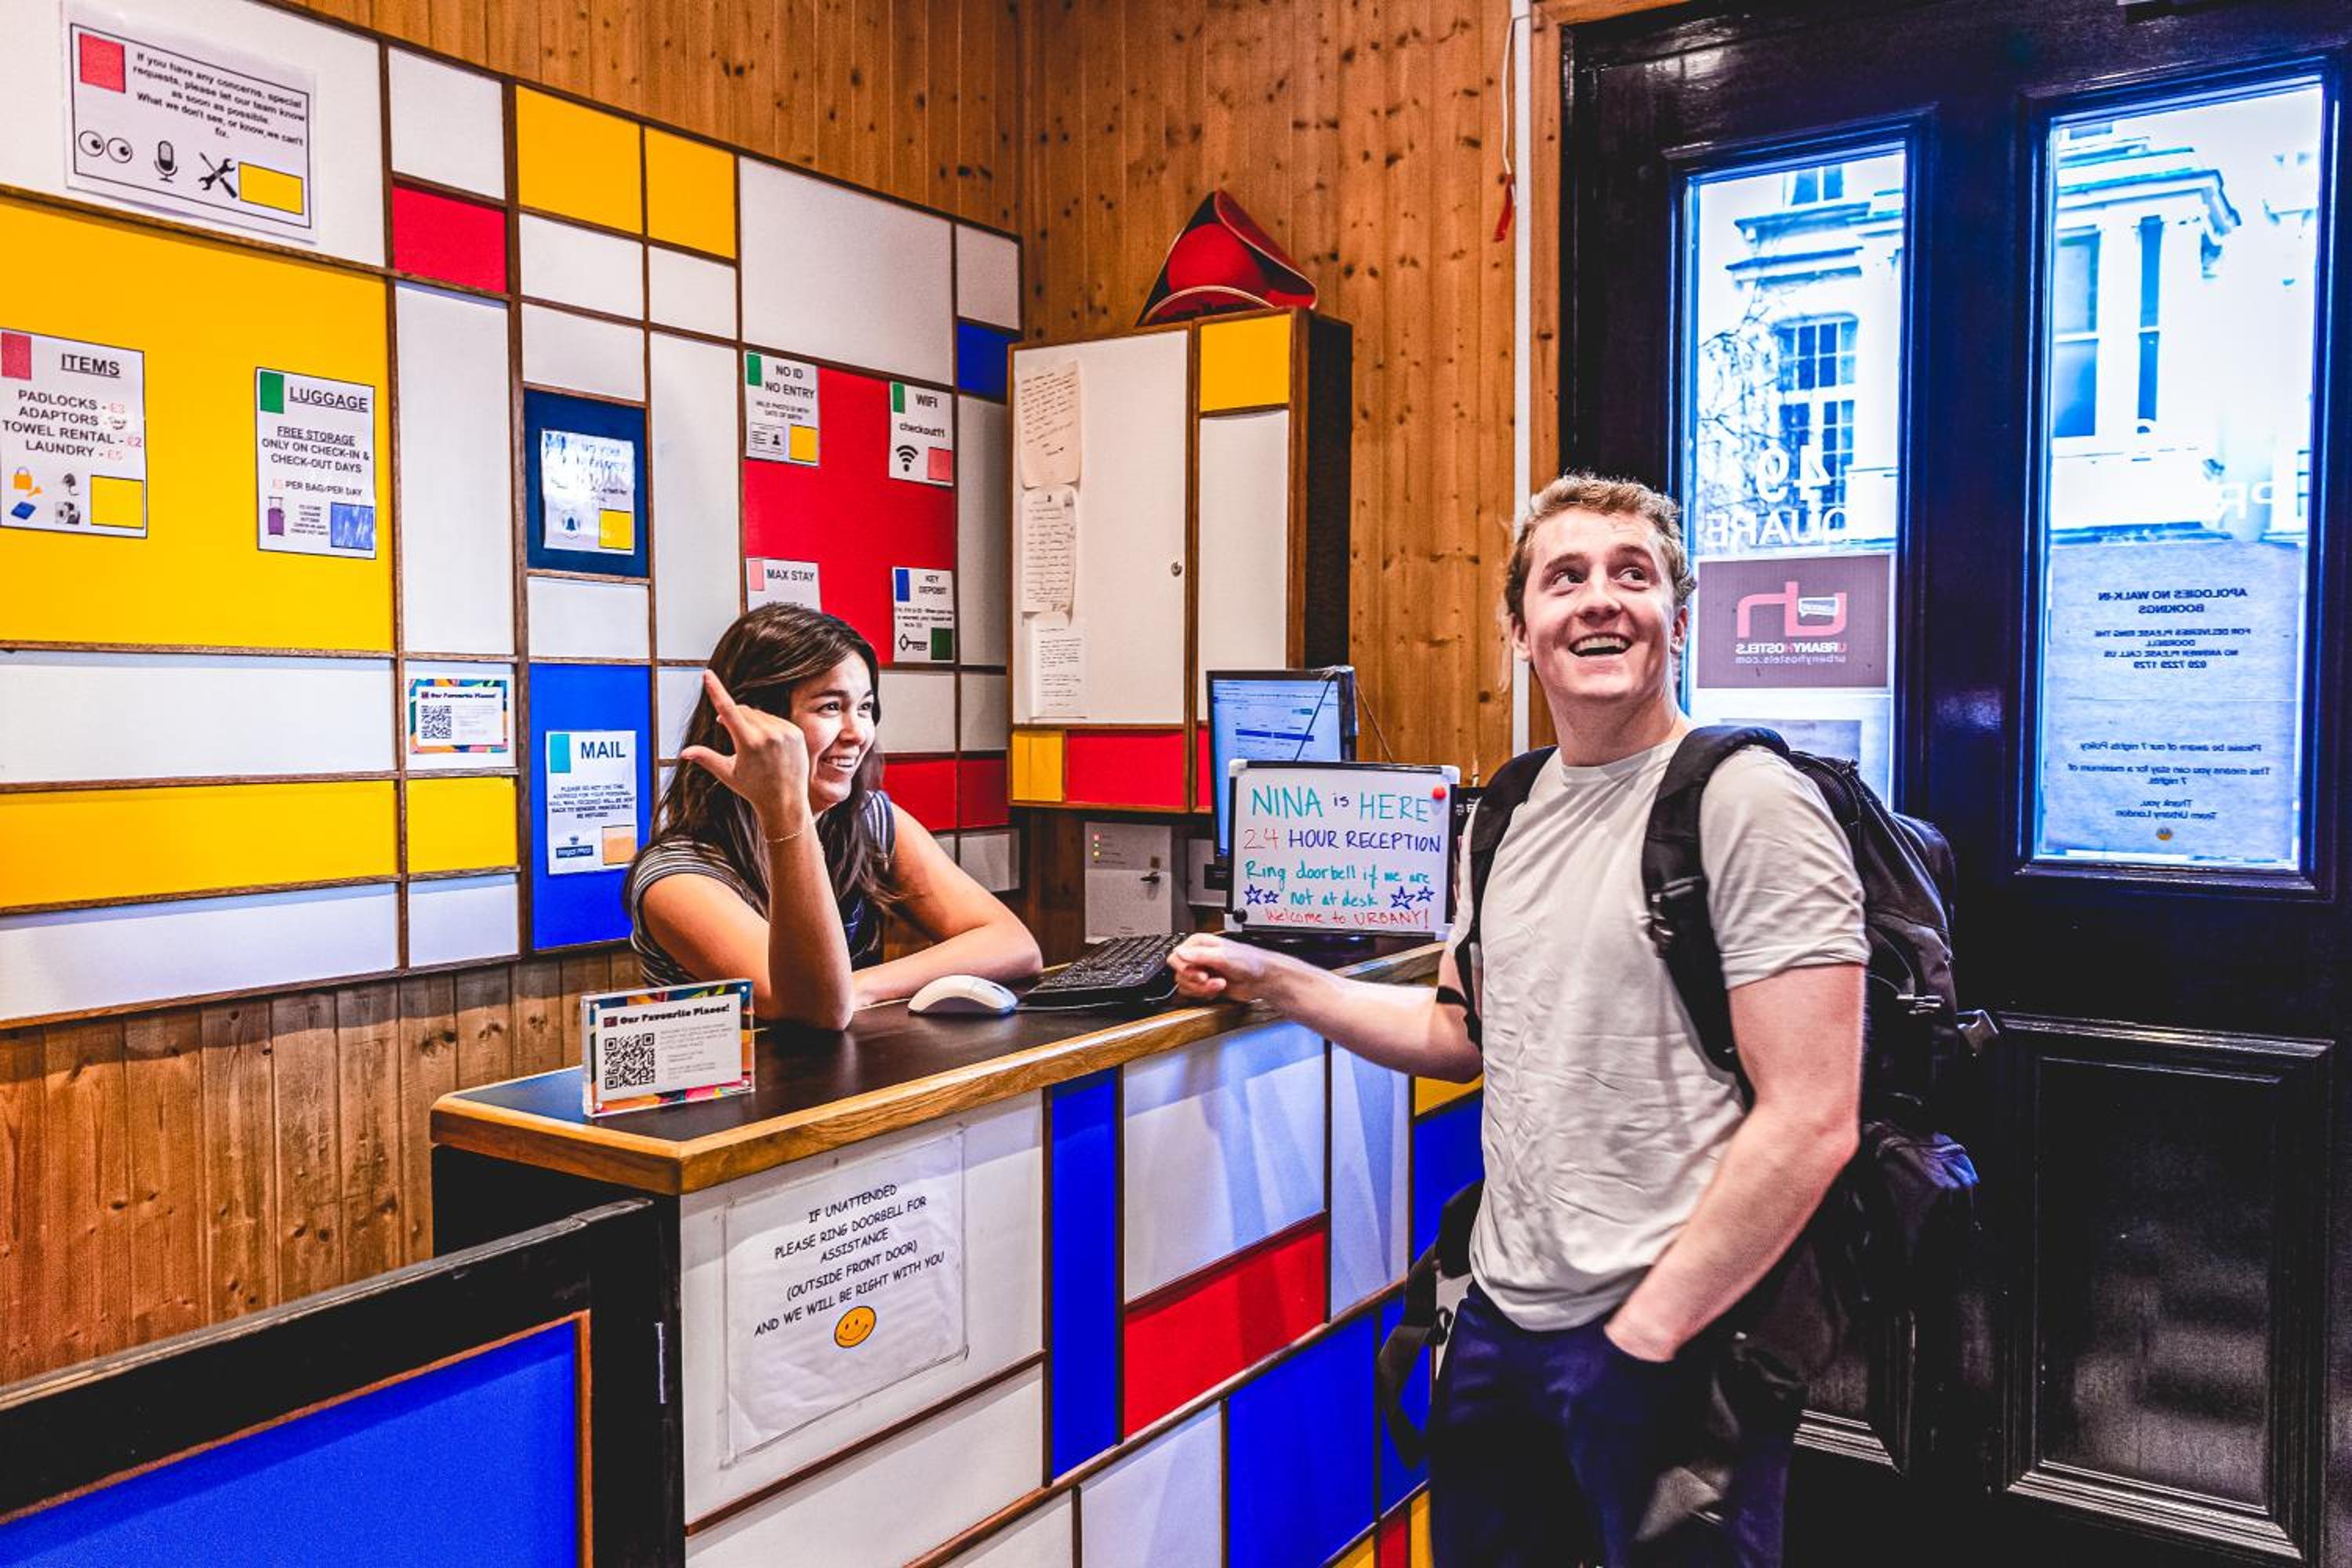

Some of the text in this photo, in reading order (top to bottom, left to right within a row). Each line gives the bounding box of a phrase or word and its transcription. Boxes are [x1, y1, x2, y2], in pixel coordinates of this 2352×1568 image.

[137, 52, 144, 61] If
[147, 56, 166, 68] you
[169, 63, 193, 76] have
[196, 72, 214, 85] any
[268, 94, 302, 108] special
[137, 93, 162, 106] What
[165, 102, 179, 111] we
[184, 82, 216, 96] please
[220, 90, 231, 100] let
[234, 96, 250, 106] our
[253, 101, 278, 114] team
[278, 108, 304, 122] know
[186, 95, 211, 107] soon
[61, 354, 121, 378] ITEMS
[775, 365, 803, 379] NO ID
[19, 390, 97, 410] PADLOCKS
[289, 387, 368, 412] LUGGAGE
[765, 382, 815, 399] NO ENTRY
[19, 406, 99, 426] ADAPTORS
[2, 419, 55, 437] TOWEL
[60, 427, 114, 445] RENTAL
[277, 426, 355, 447] FREE STORAGE
[26, 441, 95, 457] LAUNDRY
[262, 438, 289, 449] ONLY
[292, 441, 308, 452] ON
[310, 445, 360, 459] CHECK-IN
[270, 453, 361, 473] CHECK-OUT DAYS
[285, 481, 303, 489] PER
[346, 488, 362, 496] DAY
[767, 569, 814, 581] MAX STAY
[581, 741, 626, 760] MAIL
[1251, 785, 1324, 819] NINA
[1334, 792, 1349, 807] is
[1359, 790, 1432, 822] HERE
[1288, 828, 1340, 849] HOUR
[1345, 830, 1441, 853] RECEPTION
[1244, 859, 1430, 891] Ring doorbell if we are
[1290, 888, 1379, 907] not at desk
[1265, 908, 1322, 923] Welcome
[1334, 909, 1346, 925] to
[620, 1004, 730, 1025] Our Favourite Places!
[808, 1184, 897, 1224] IF UNATTENDED
[775, 1196, 927, 1260] PLEASE RING DOORBELL FOR
[820, 1228, 889, 1264] ASSISTANCE
[786, 1240, 918, 1301] (OUTSIDE FRONT DOOR)
[753, 1252, 945, 1337] AND WE WILL BE RIGHT WITH YOU
